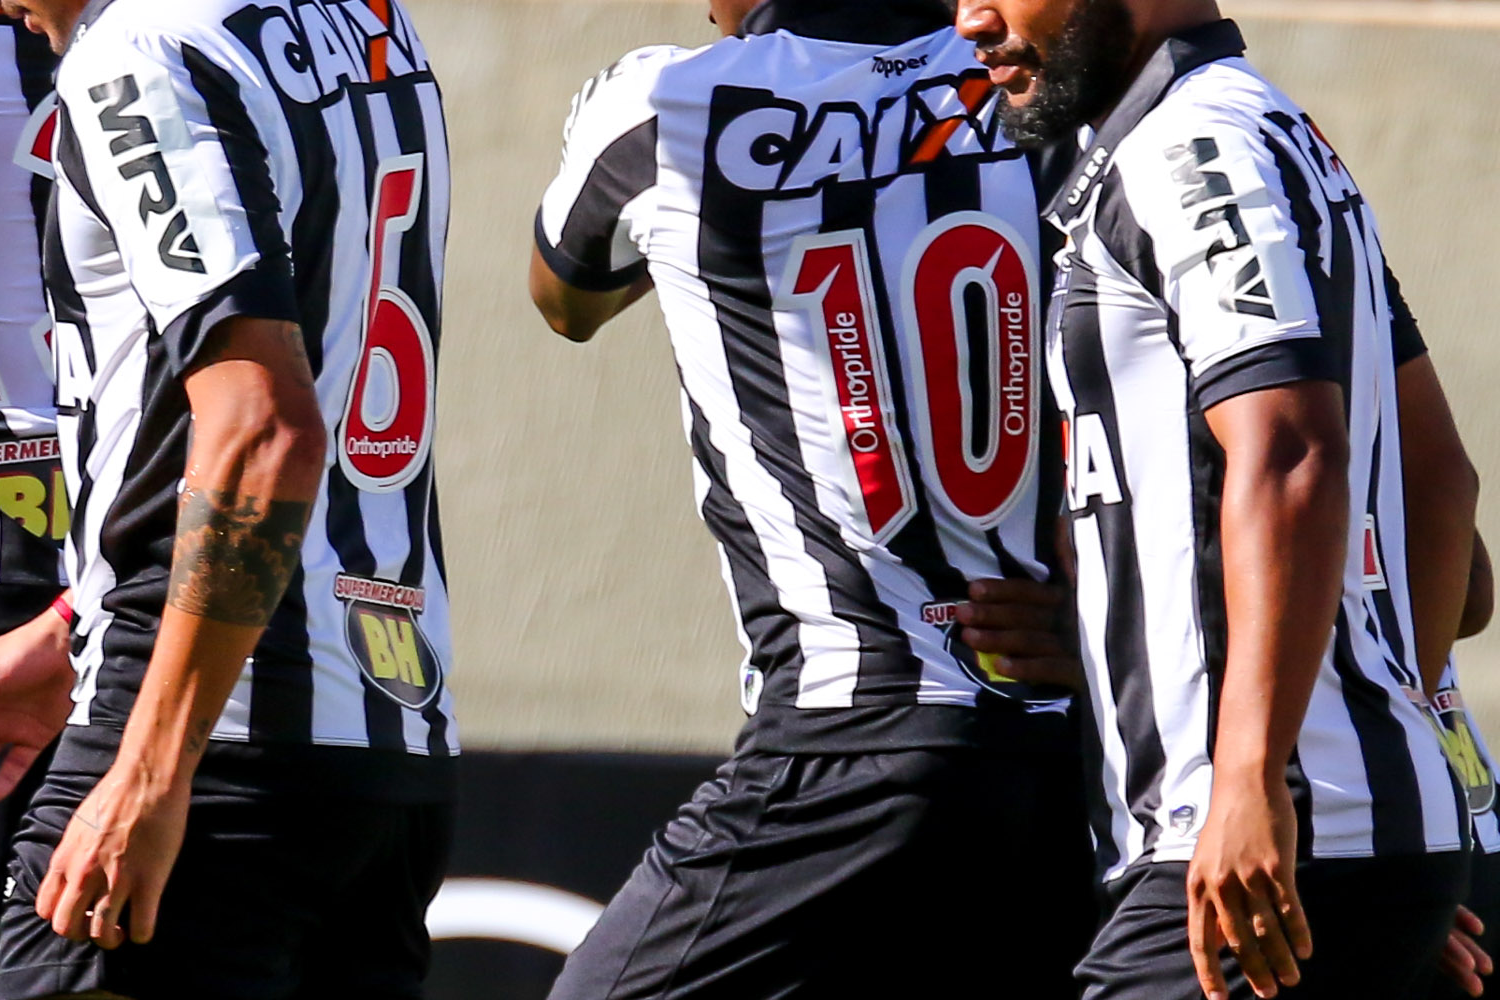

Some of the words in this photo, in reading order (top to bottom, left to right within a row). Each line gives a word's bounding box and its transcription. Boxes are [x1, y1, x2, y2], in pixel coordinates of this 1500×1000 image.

[871, 54, 929, 78] Topper
[88, 73, 208, 275] MRV
[1163, 136, 1278, 321] MRV
[338, 153, 434, 494] 6
[776, 210, 1041, 546] 10
[828, 311, 879, 454] Orthopride
[1003, 291, 1030, 437] Orthopride
[347, 434, 417, 459] Orthopride
[335, 576, 424, 611] SUPERMERCAD
[357, 608, 426, 688] BH
